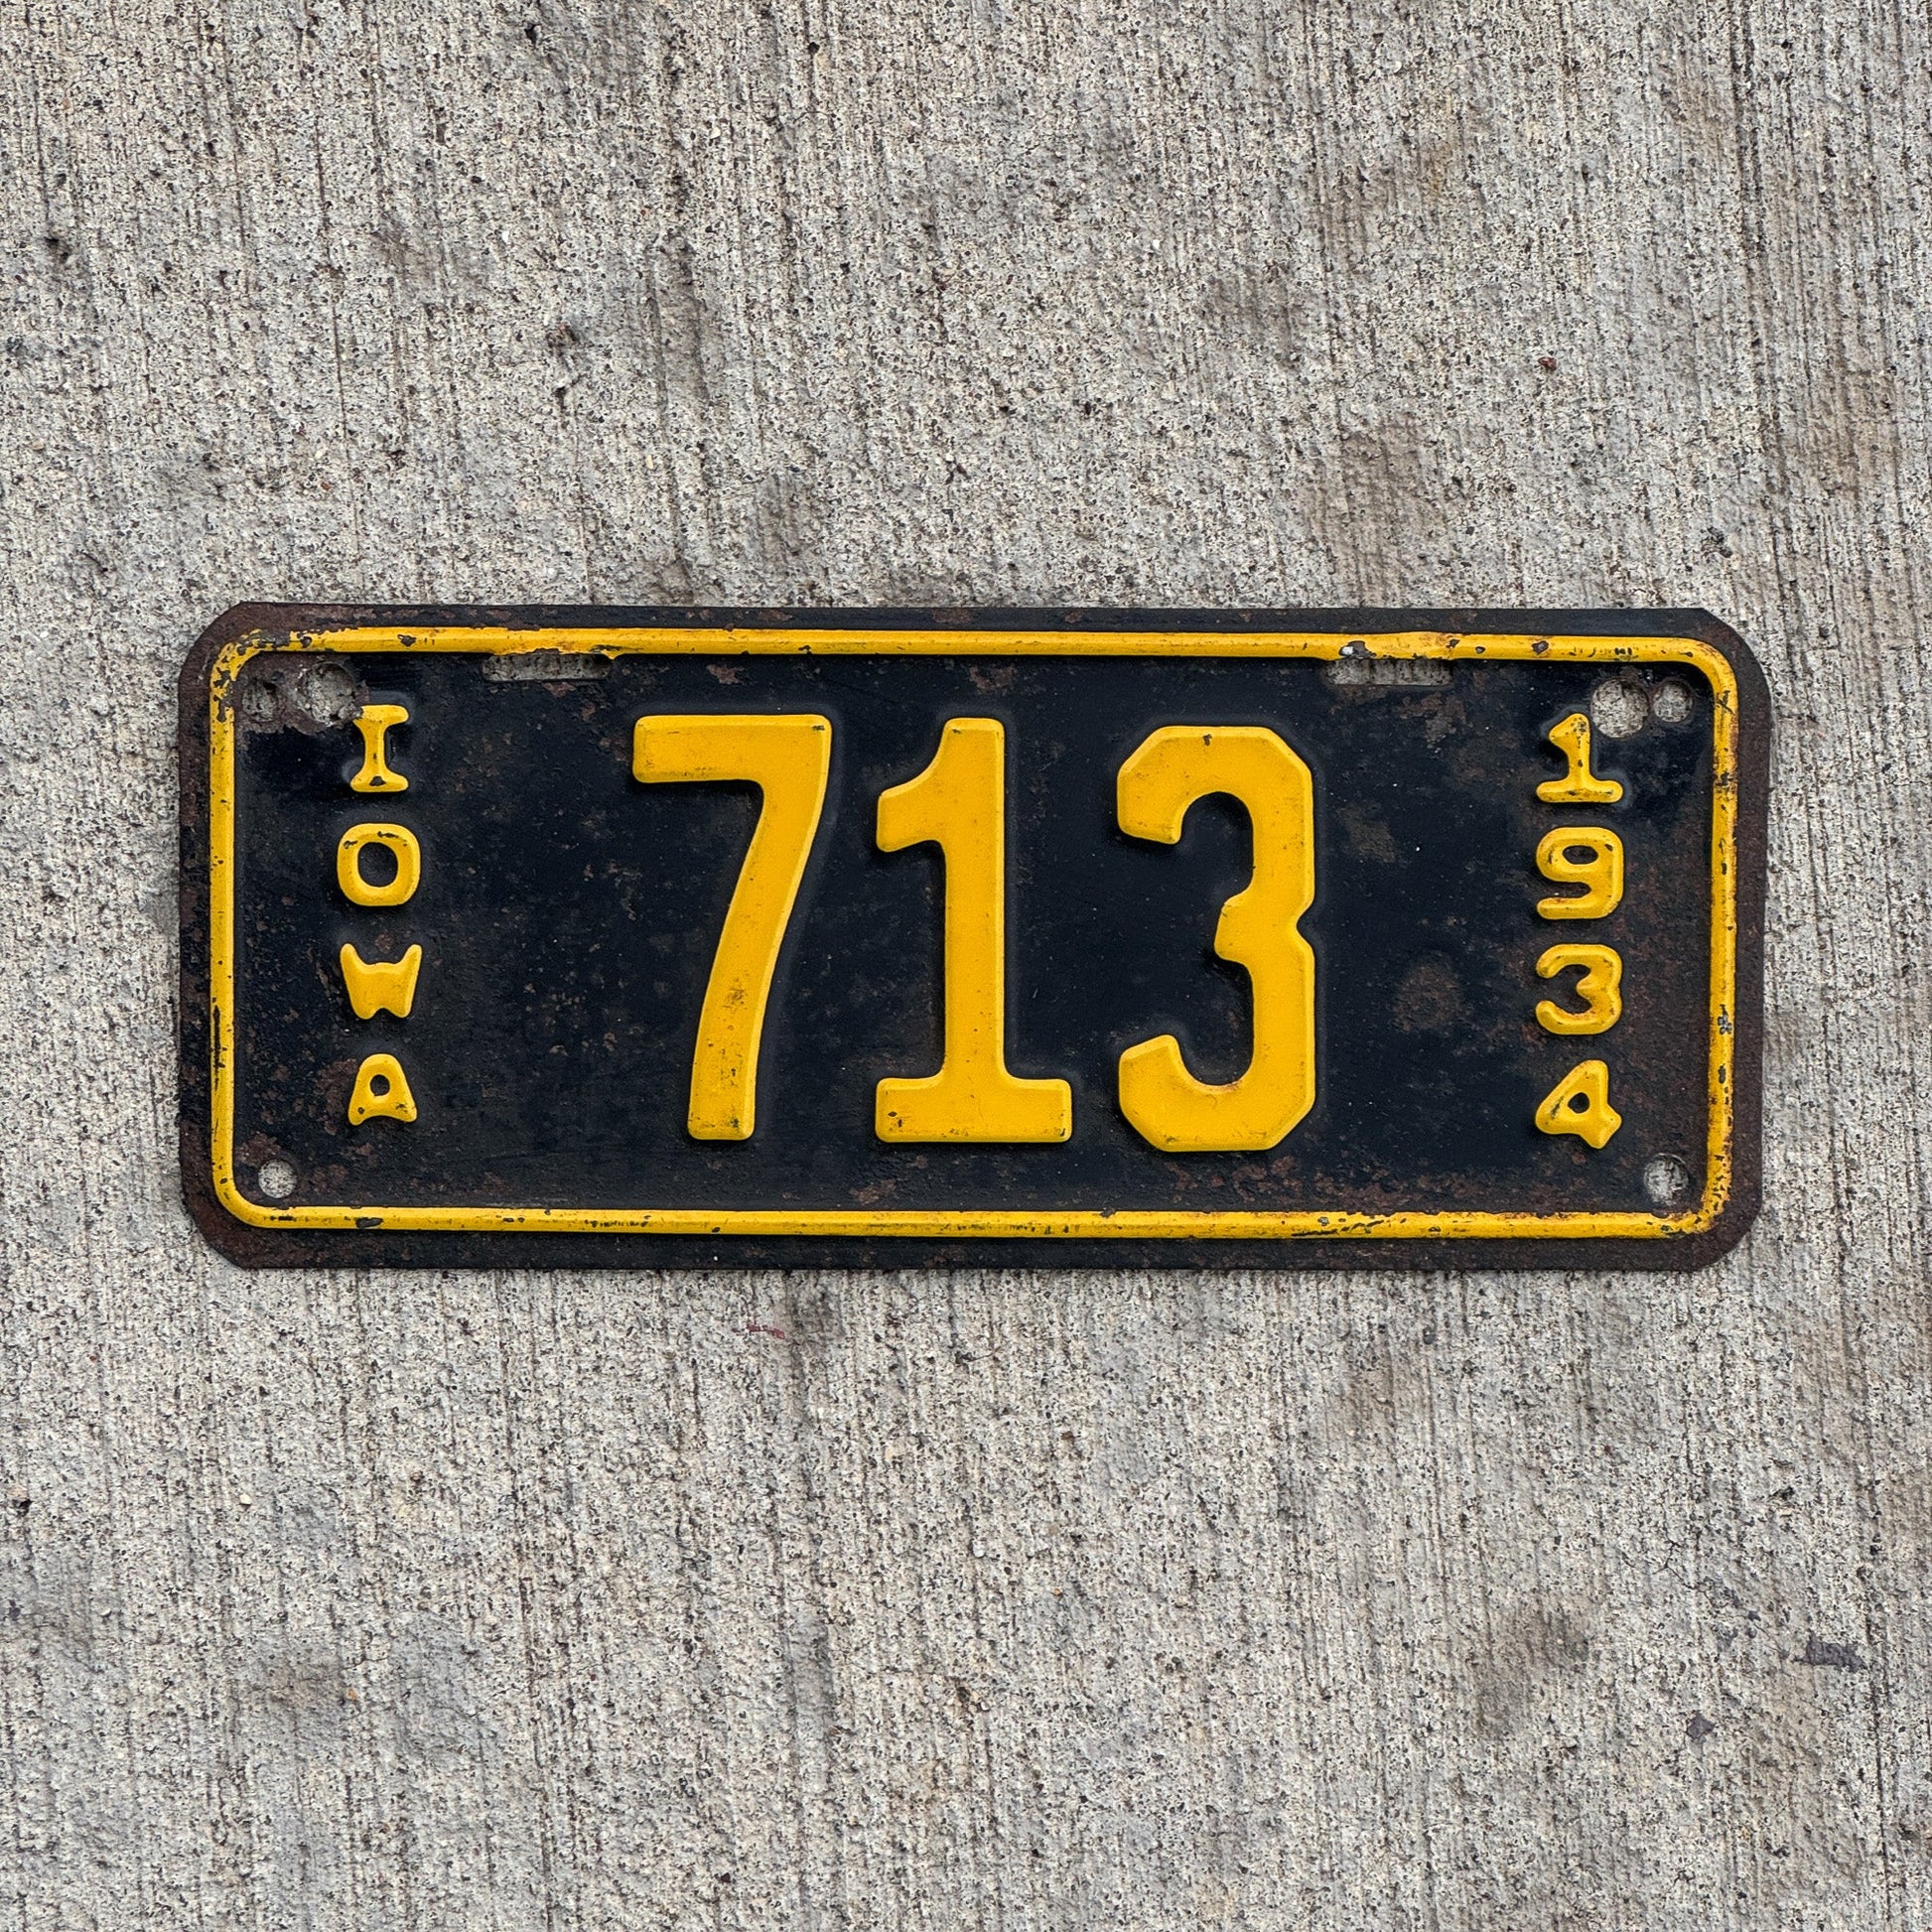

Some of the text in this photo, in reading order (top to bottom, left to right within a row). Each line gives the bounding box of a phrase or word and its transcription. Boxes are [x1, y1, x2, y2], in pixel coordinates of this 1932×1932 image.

[337, 704, 423, 1126] IOWA
[631, 713, 1316, 1153] 713
[1535, 713, 1624, 1150] 1934
